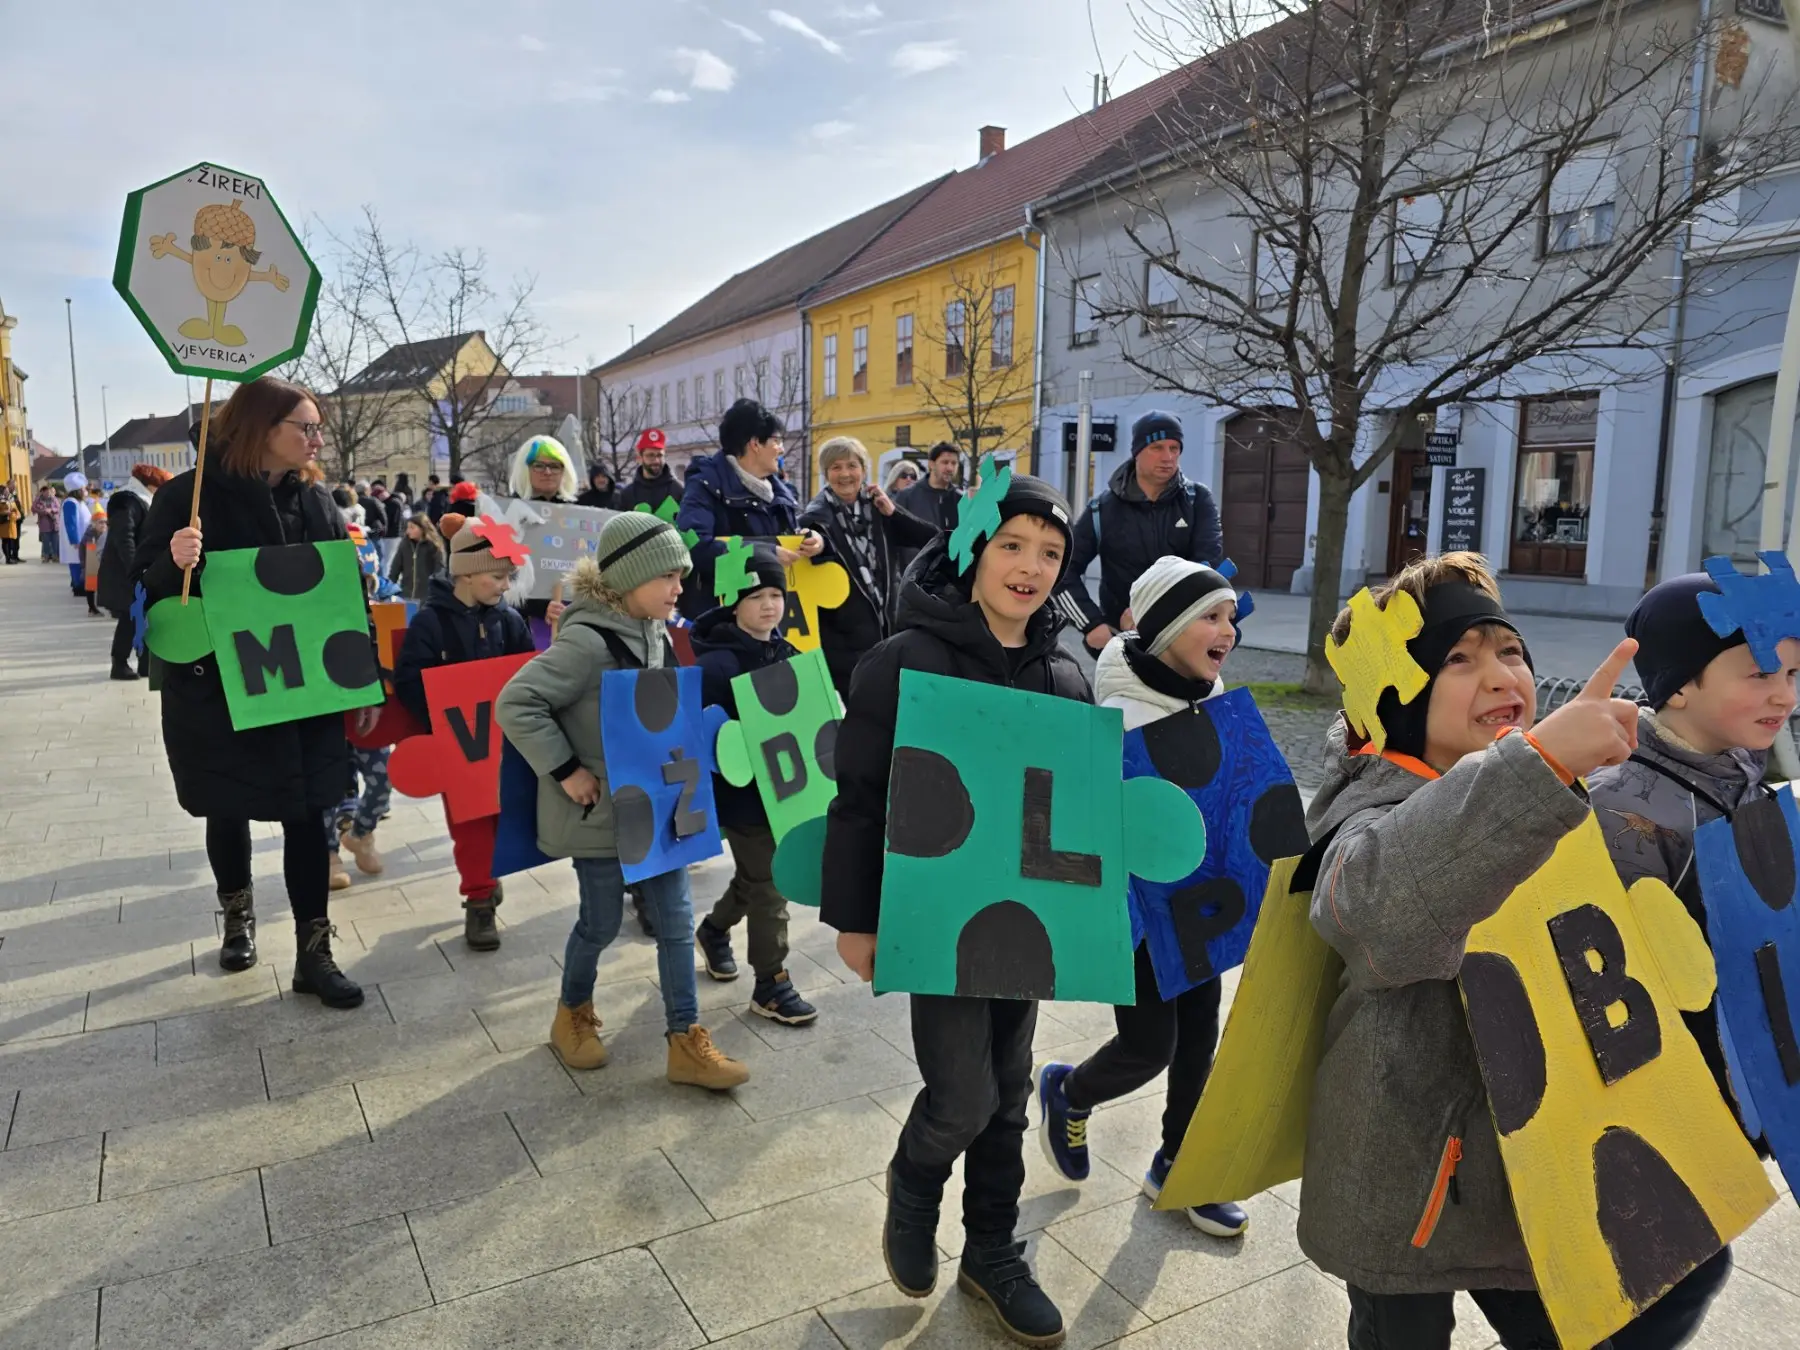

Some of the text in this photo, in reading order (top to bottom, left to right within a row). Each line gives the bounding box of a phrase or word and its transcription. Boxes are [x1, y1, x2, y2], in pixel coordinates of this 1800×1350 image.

[1448, 507, 1476, 516] VOGUE
[232, 624, 305, 697] M
[444, 701, 492, 762] V
[760, 732, 808, 802] D
[661, 747, 707, 841] Ž
[1021, 767, 1102, 888] L
[1170, 877, 1246, 983] P
[1547, 903, 1662, 1087] B
